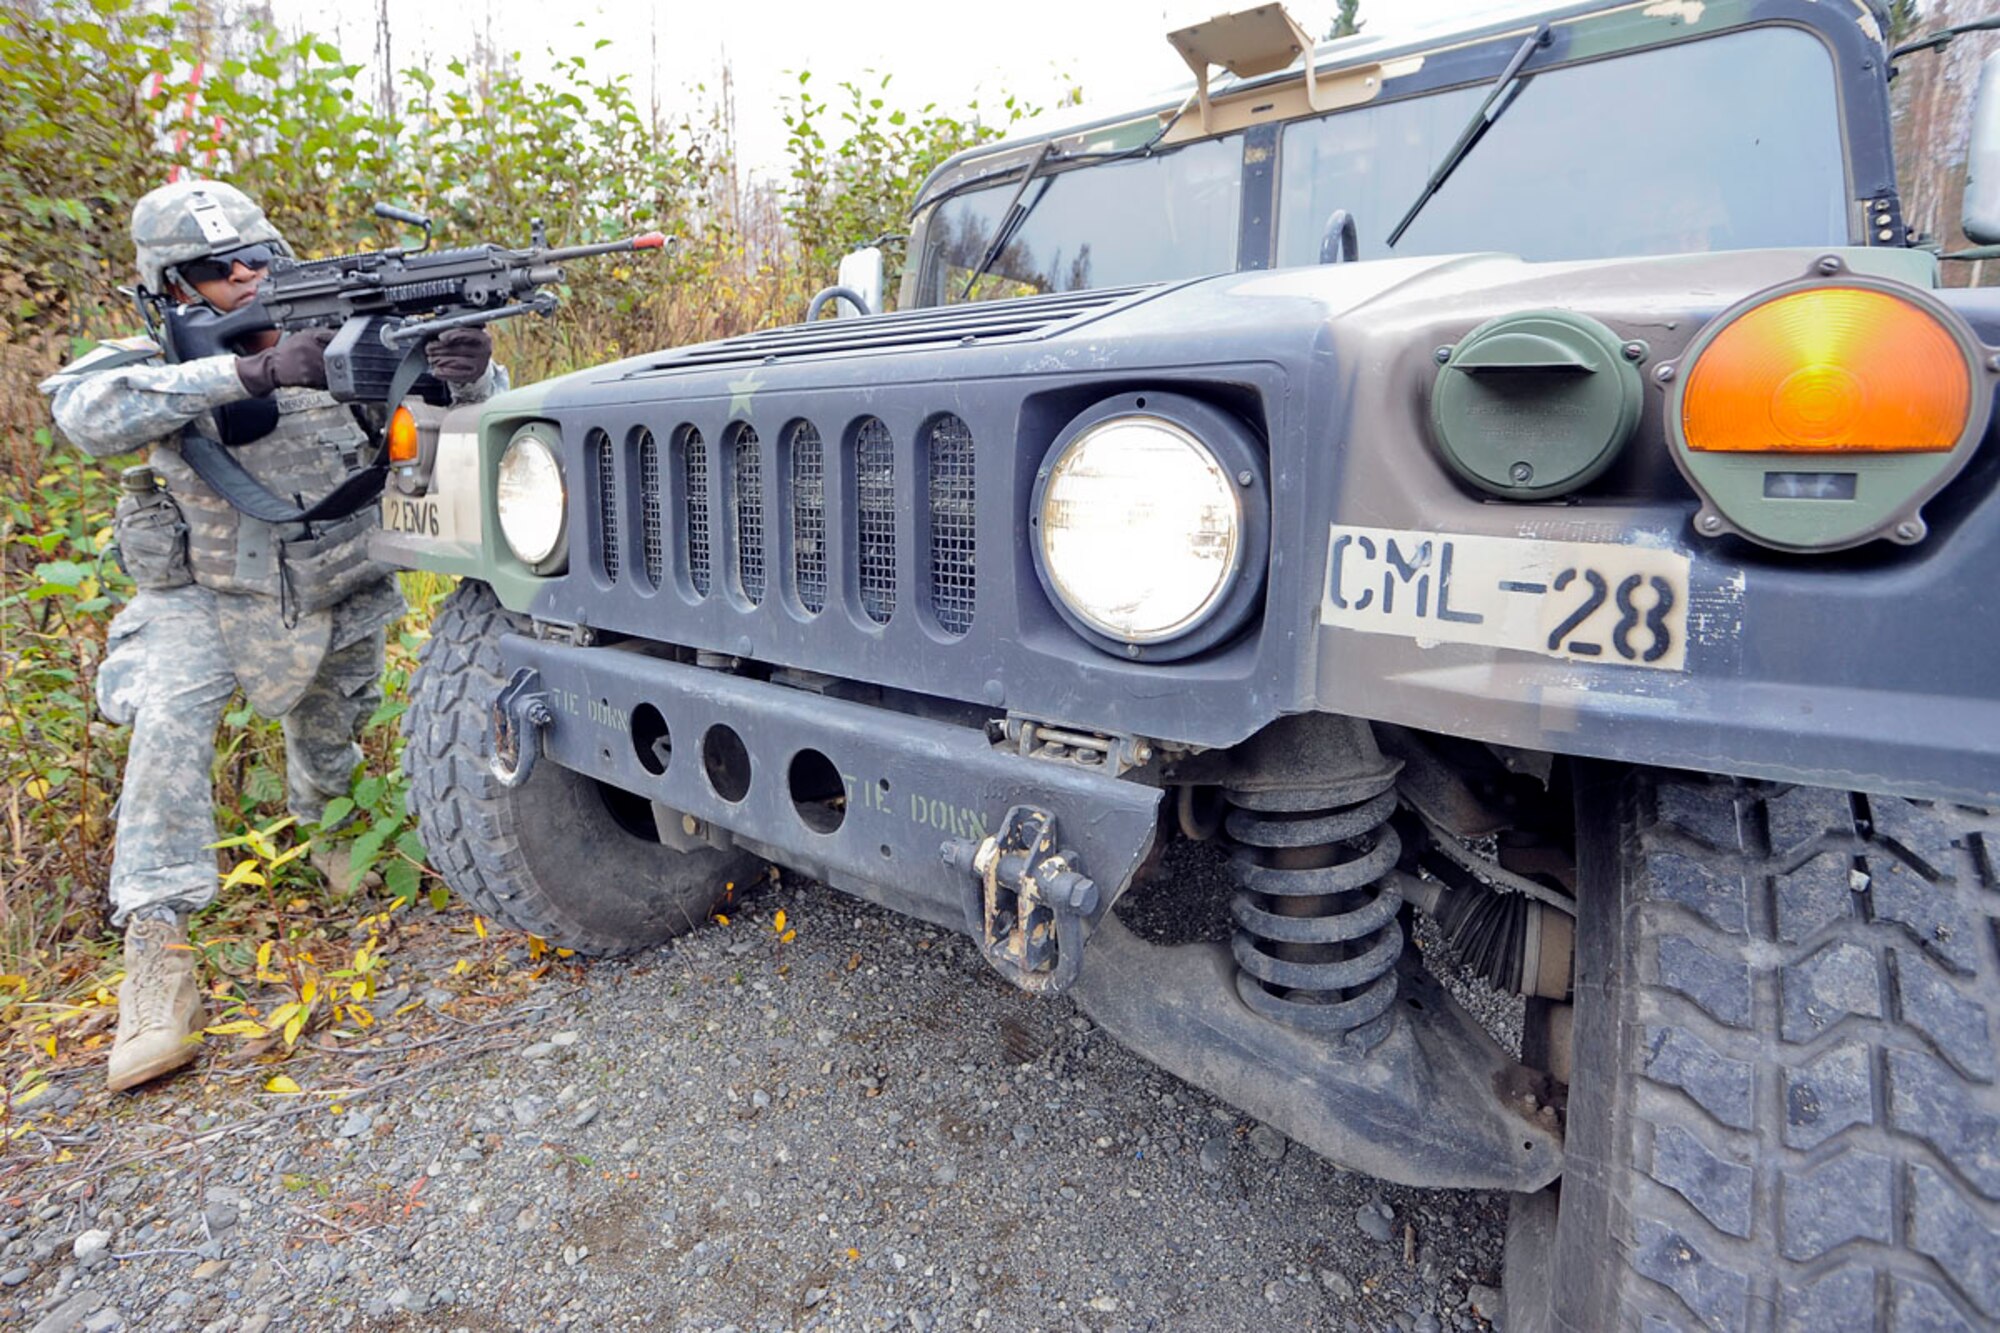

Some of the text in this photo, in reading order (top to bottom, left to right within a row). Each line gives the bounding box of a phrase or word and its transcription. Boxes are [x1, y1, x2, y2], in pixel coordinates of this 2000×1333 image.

[552, 687, 580, 716] TIE
[842, 774, 988, 841] TIE DOWN
